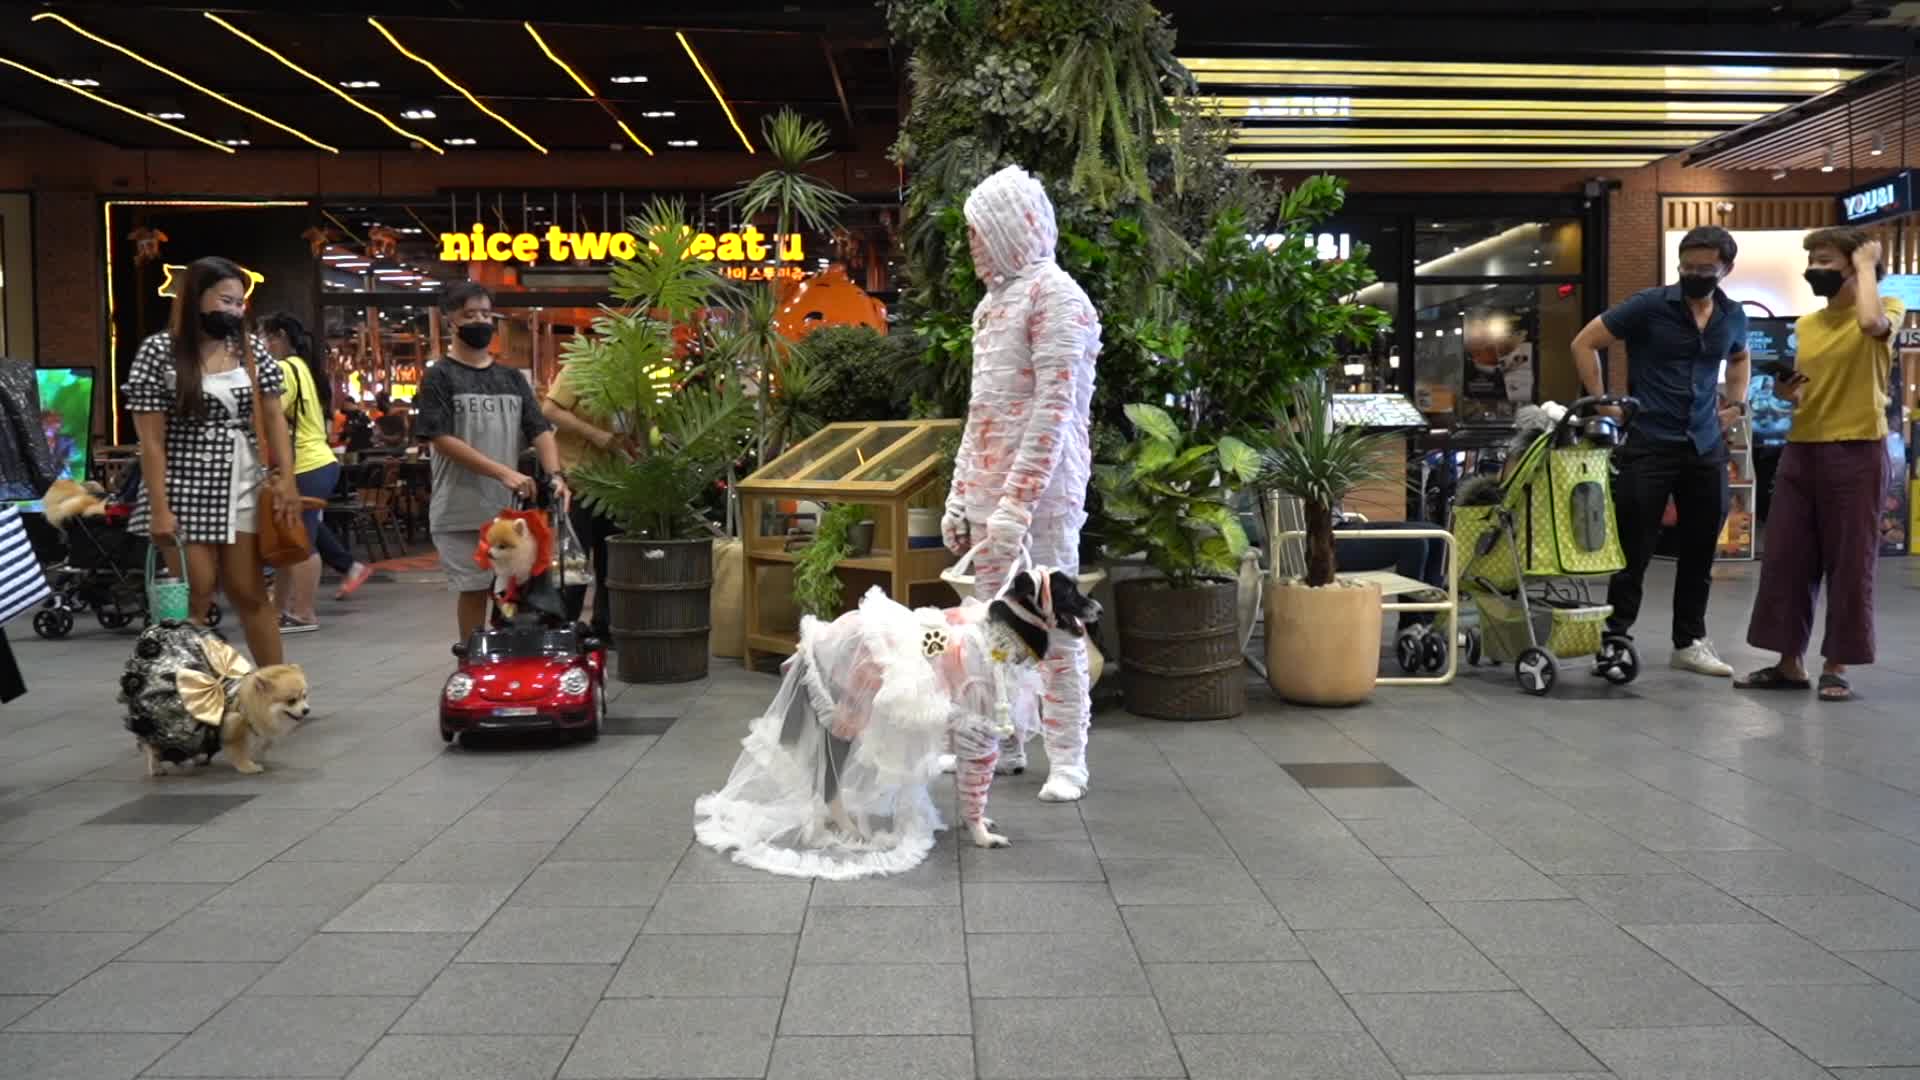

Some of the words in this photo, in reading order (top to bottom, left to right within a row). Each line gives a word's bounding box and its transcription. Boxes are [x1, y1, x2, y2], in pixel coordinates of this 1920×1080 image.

[440, 223, 539, 261] nice
[545, 225, 637, 261] two
[773, 232, 804, 261] u
[452, 397, 519, 414] BEGIN
